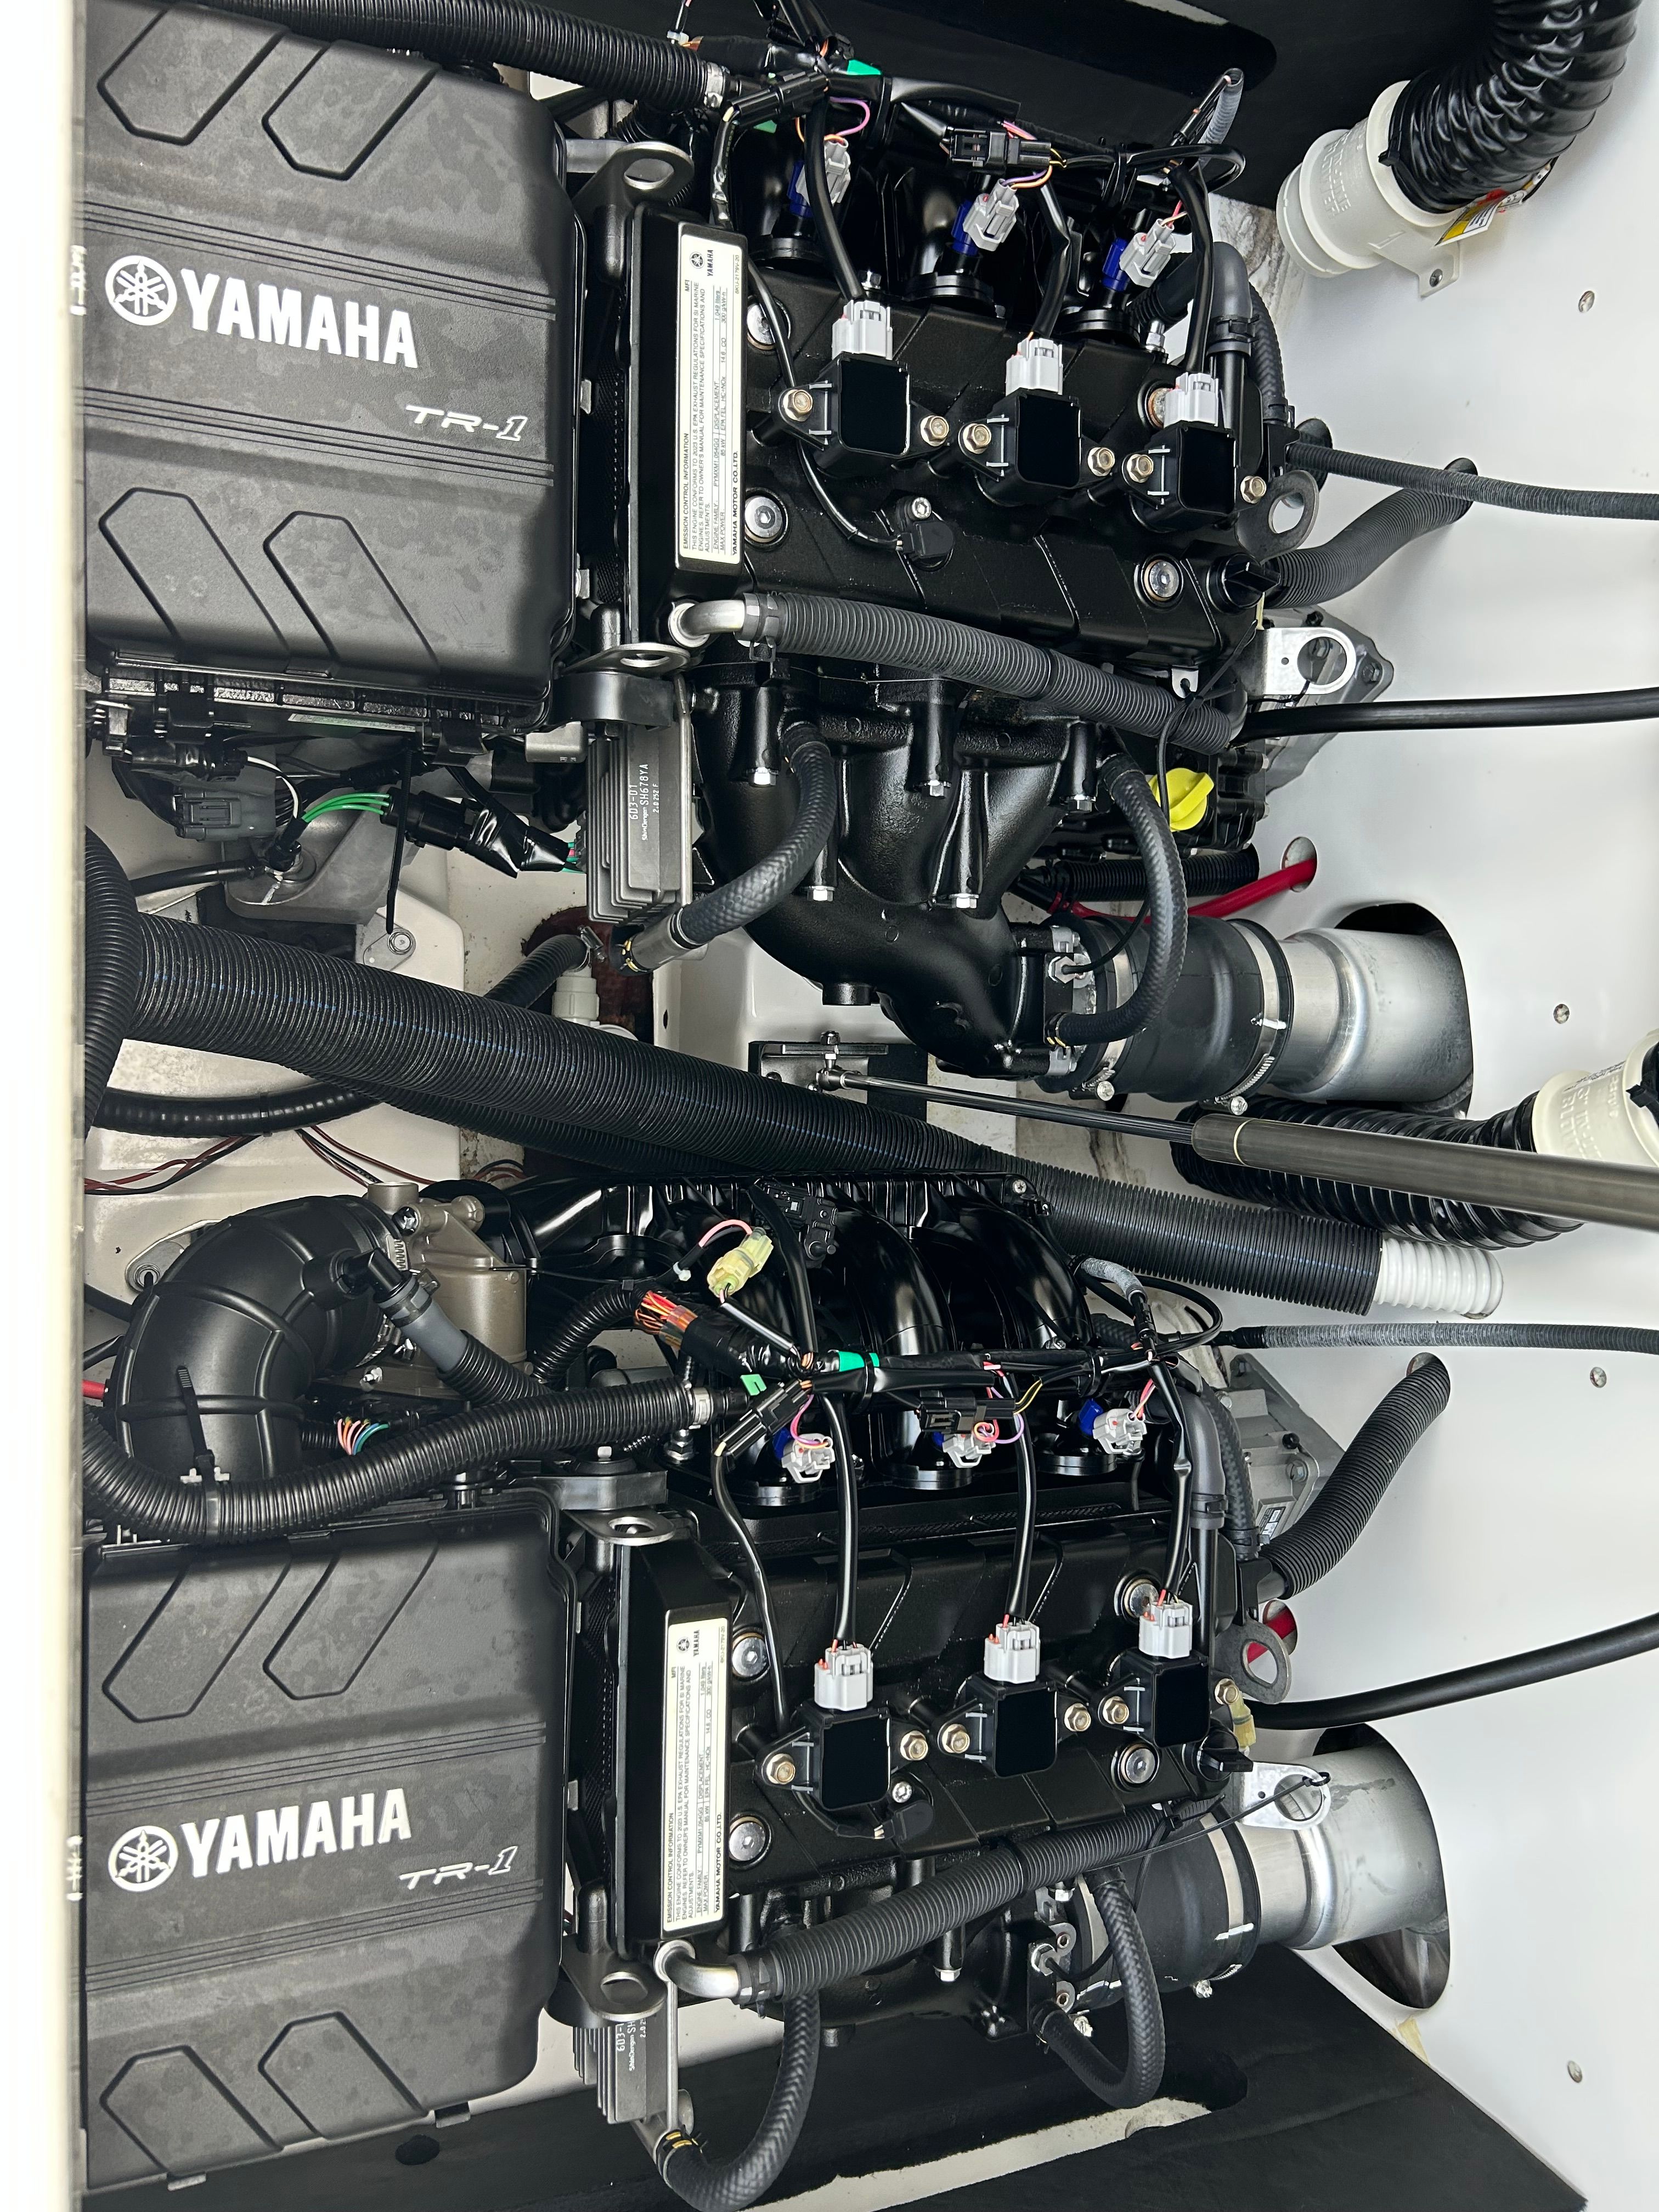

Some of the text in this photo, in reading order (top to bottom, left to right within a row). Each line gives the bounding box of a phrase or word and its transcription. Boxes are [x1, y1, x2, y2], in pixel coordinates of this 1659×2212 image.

[180, 268, 419, 369] YAMAHA
[405, 404, 529, 442] TR-1
[720, 439, 725, 448] kW
[692, 459, 697, 467] TO
[699, 486, 703, 494] TO
[639, 764, 648, 805] SH678YA
[180, 1788, 412, 1878] YAMAHA
[677, 1833, 682, 1842] TO
[399, 1846, 518, 1889] TR-1
[683, 1858, 687, 1866] TO
